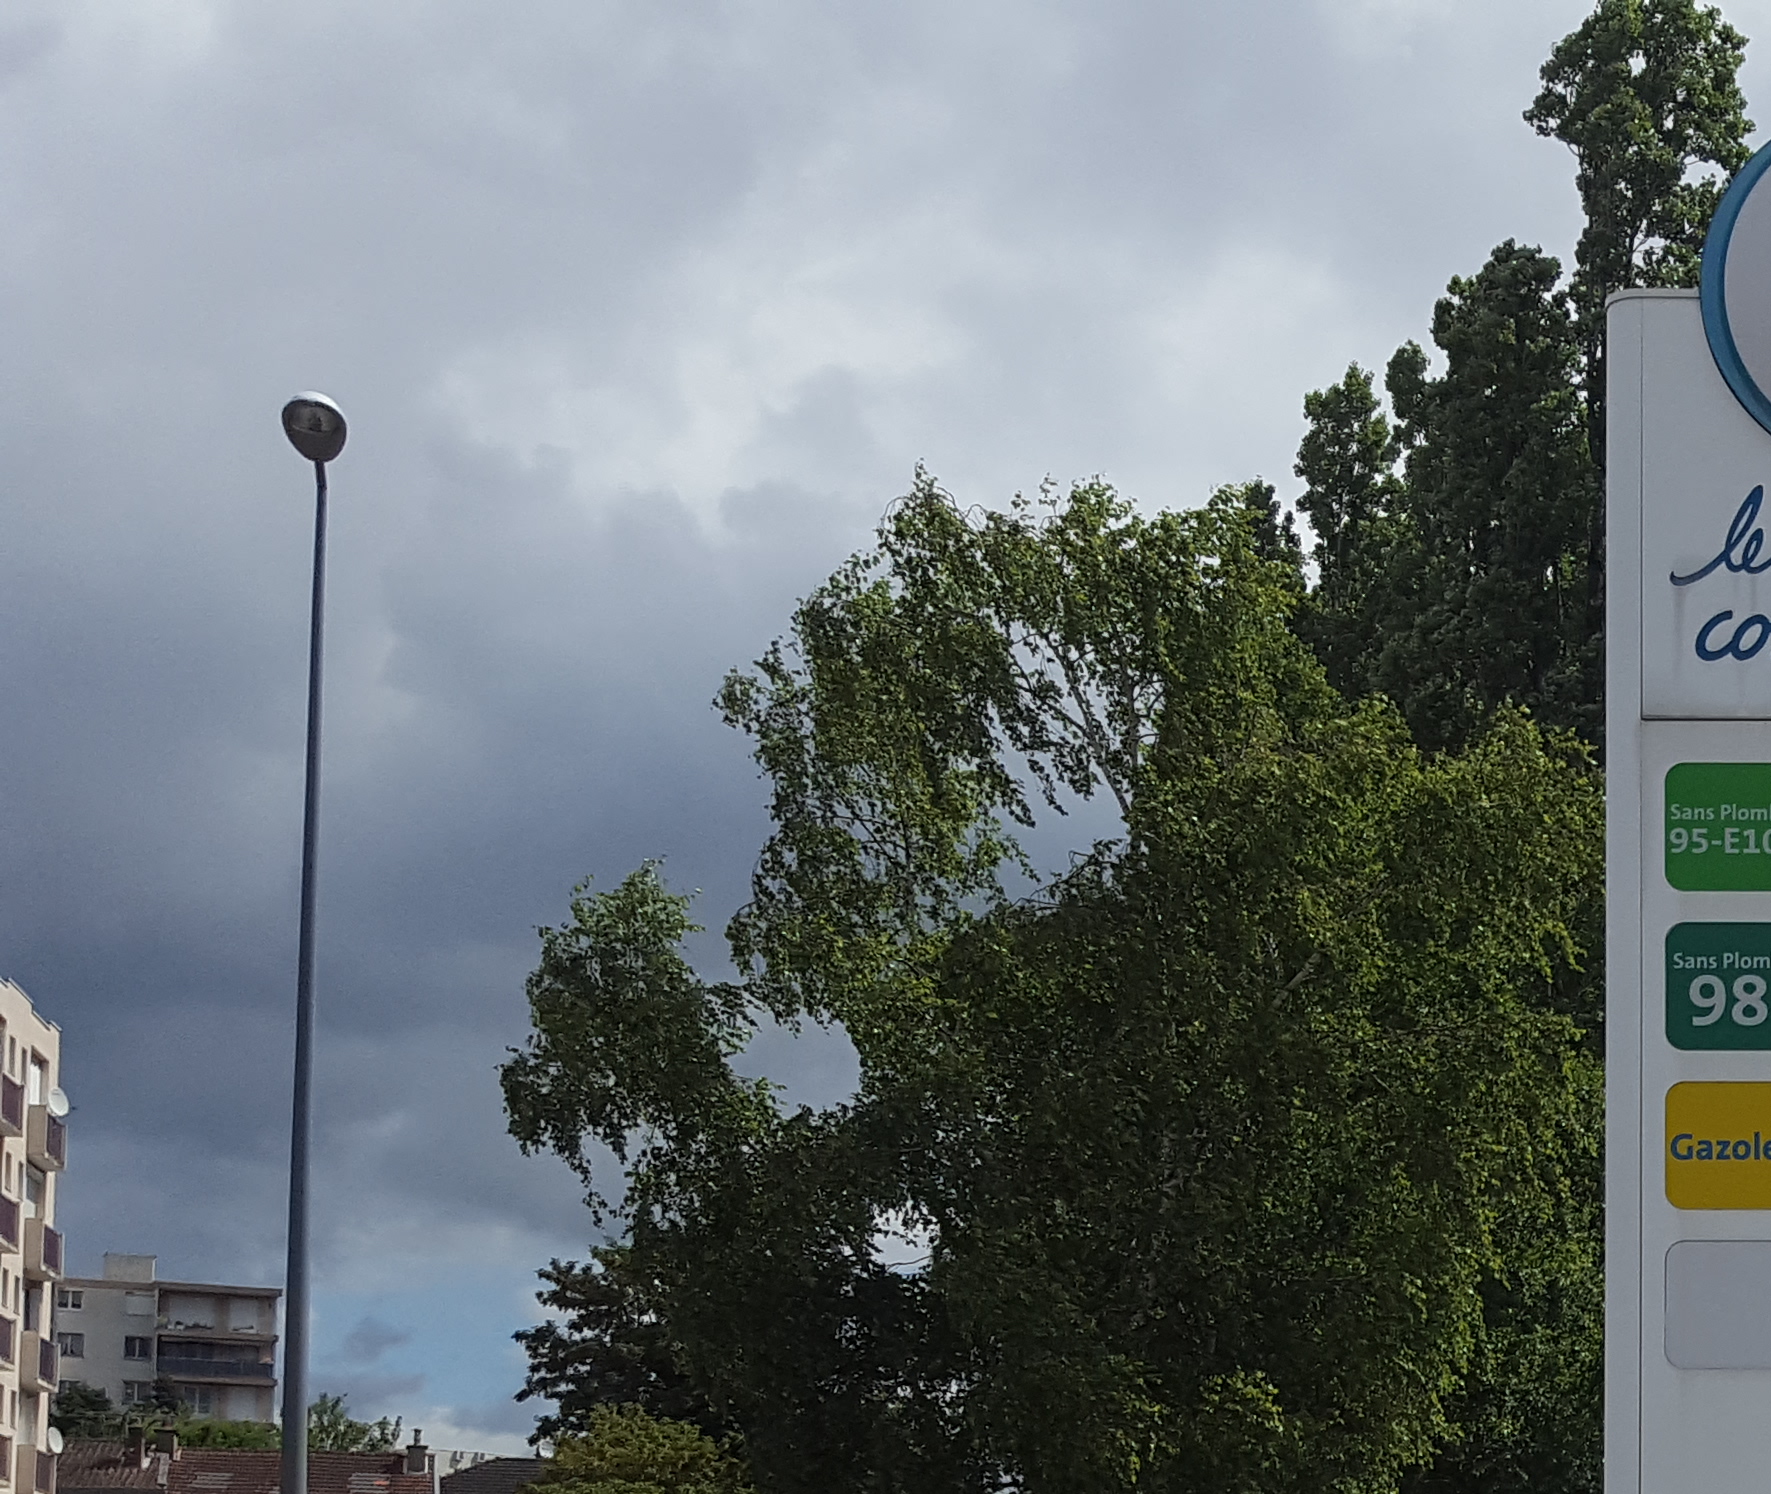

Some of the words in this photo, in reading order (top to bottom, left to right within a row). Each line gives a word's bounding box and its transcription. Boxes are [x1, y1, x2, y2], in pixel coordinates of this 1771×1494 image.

[1670, 803, 1715, 822] Sans
[1673, 952, 1718, 970] Sans
[1688, 974, 1769, 1027] 98
